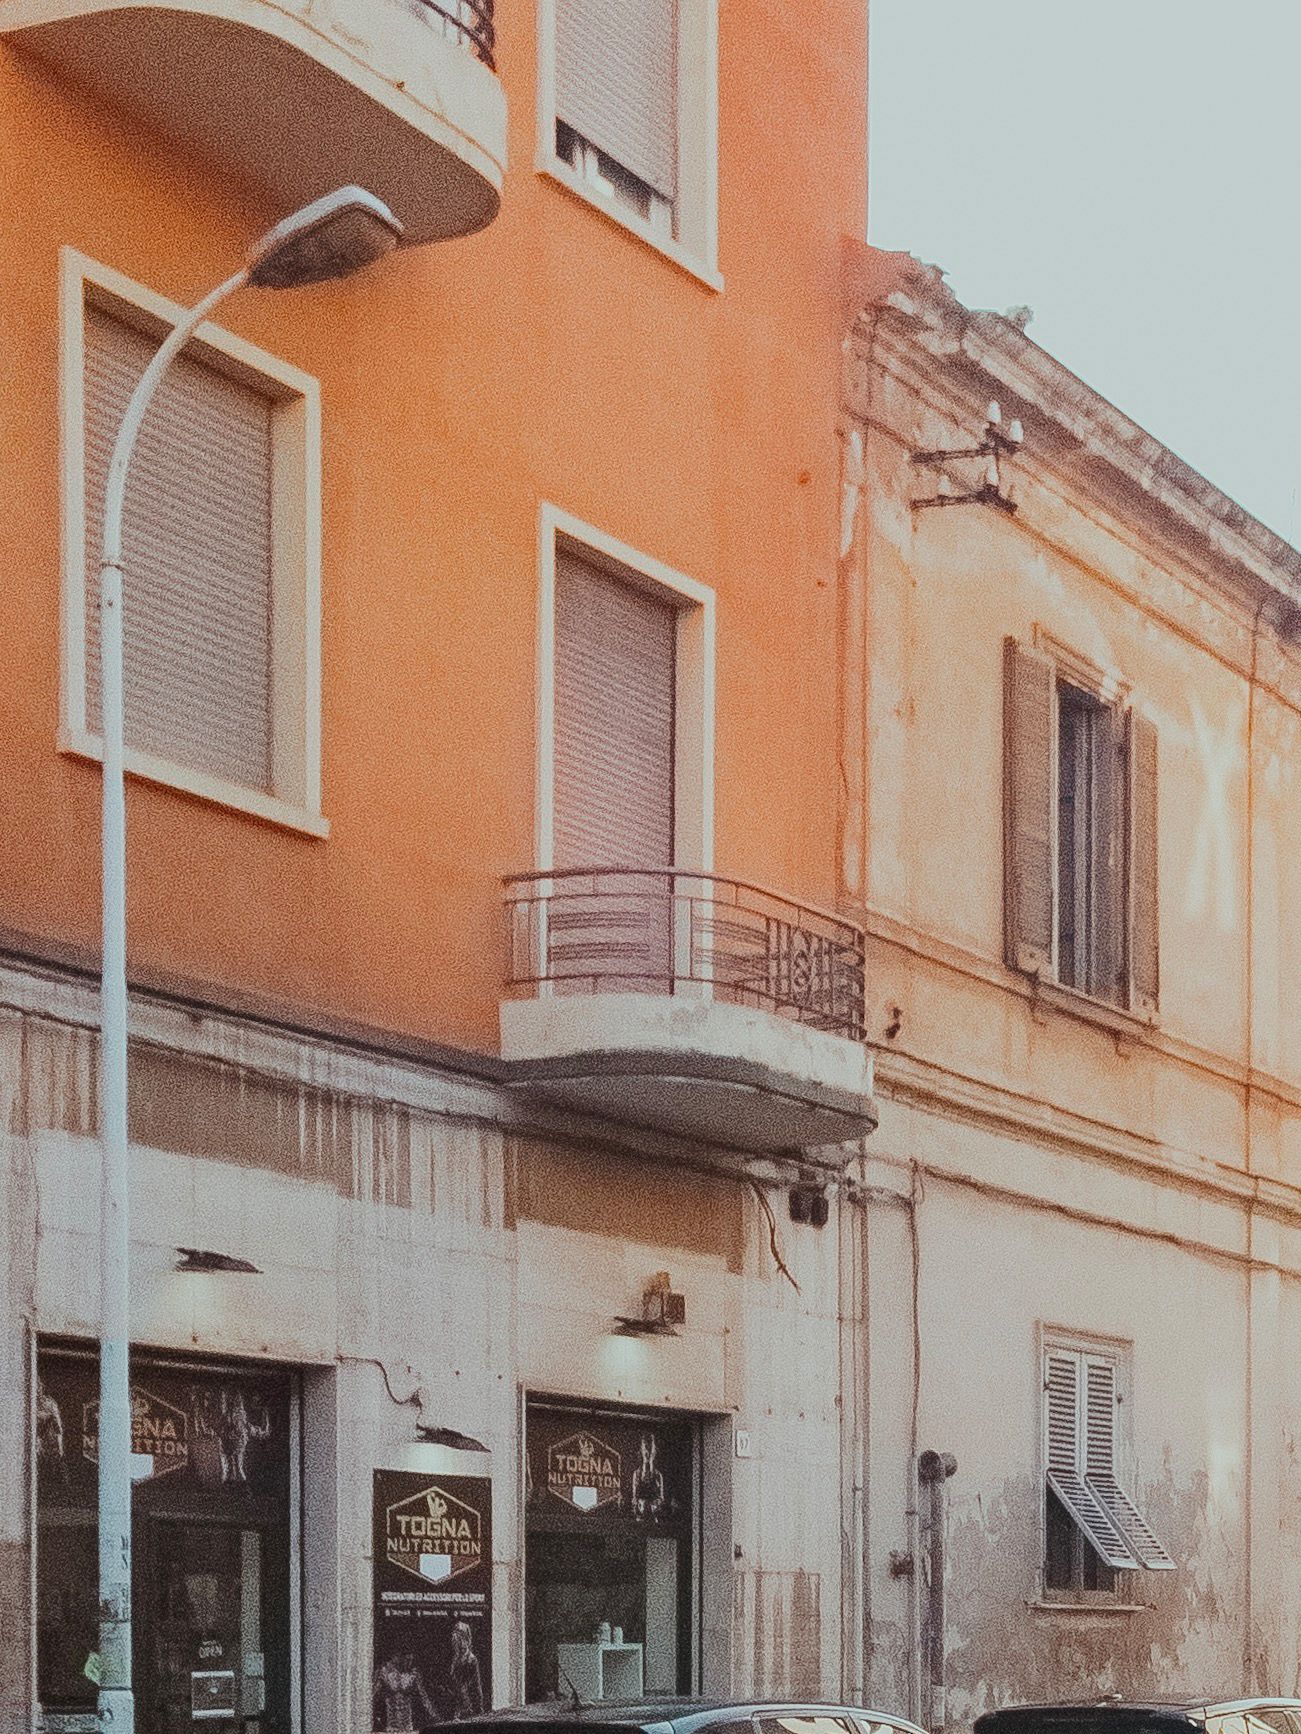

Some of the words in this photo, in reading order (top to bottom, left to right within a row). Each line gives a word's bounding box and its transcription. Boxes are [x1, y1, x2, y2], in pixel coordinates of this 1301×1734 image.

[82, 1434, 188, 1455] NITION
[555, 1453, 614, 1475] TOGNA
[548, 1472, 621, 1489] NUTRITION
[396, 1515, 472, 1539] TOGNA
[387, 1538, 482, 1556] NUTRITION
